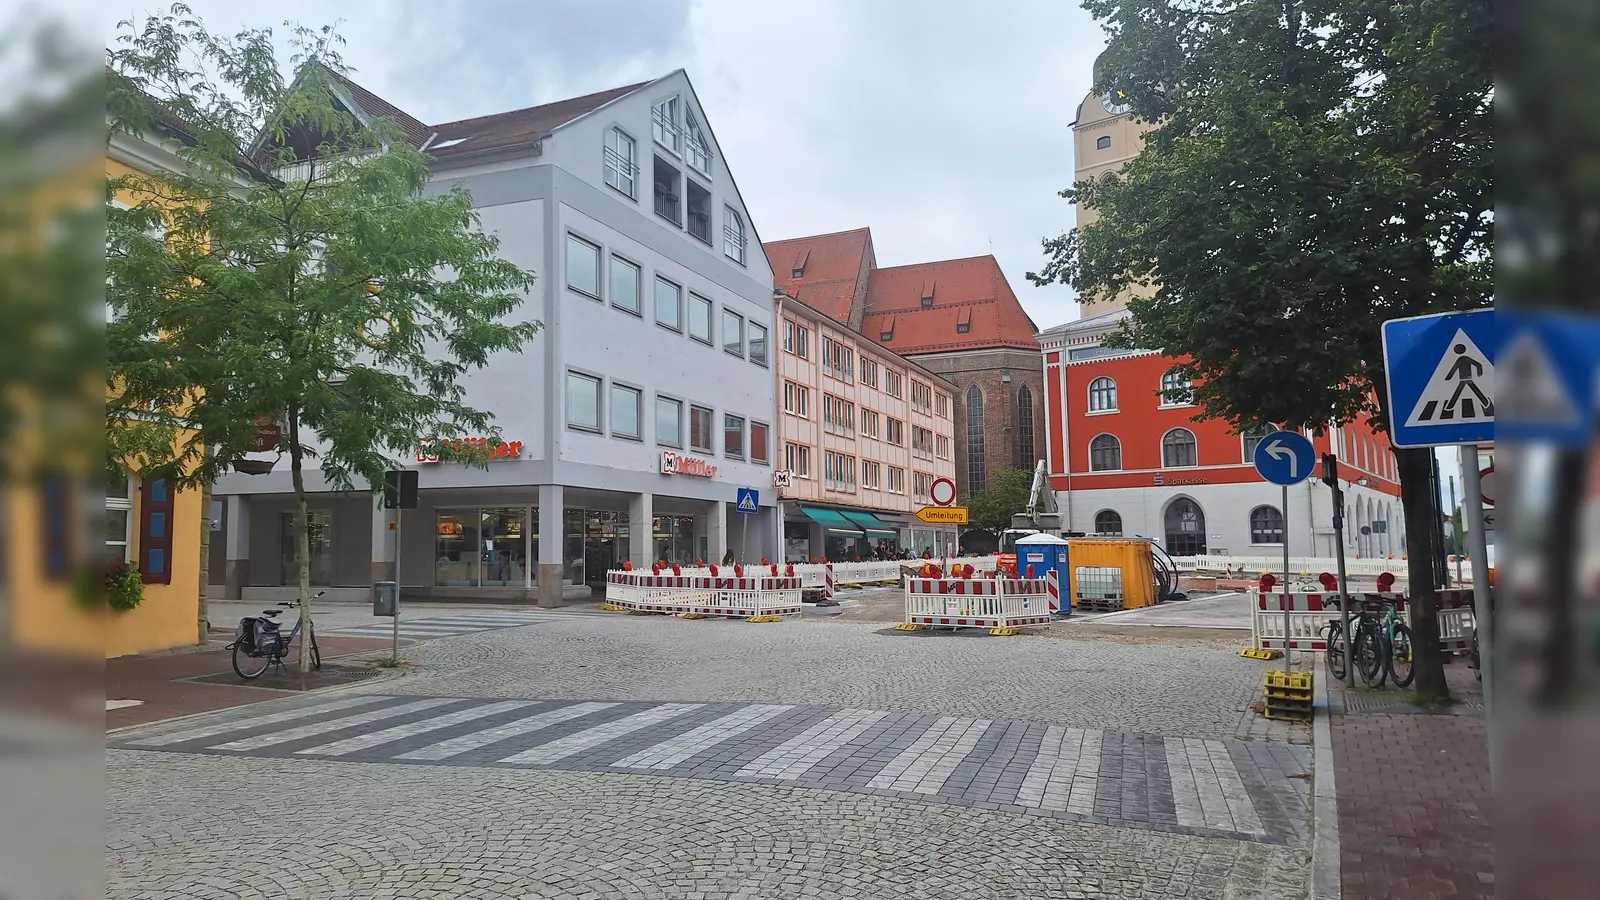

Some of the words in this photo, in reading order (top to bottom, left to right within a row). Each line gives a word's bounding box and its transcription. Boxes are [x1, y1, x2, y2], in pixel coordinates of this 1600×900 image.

[678, 455, 718, 477] Müller
[1168, 477, 1208, 485] Sparkasse
[925, 511, 963, 522] Umleitung
